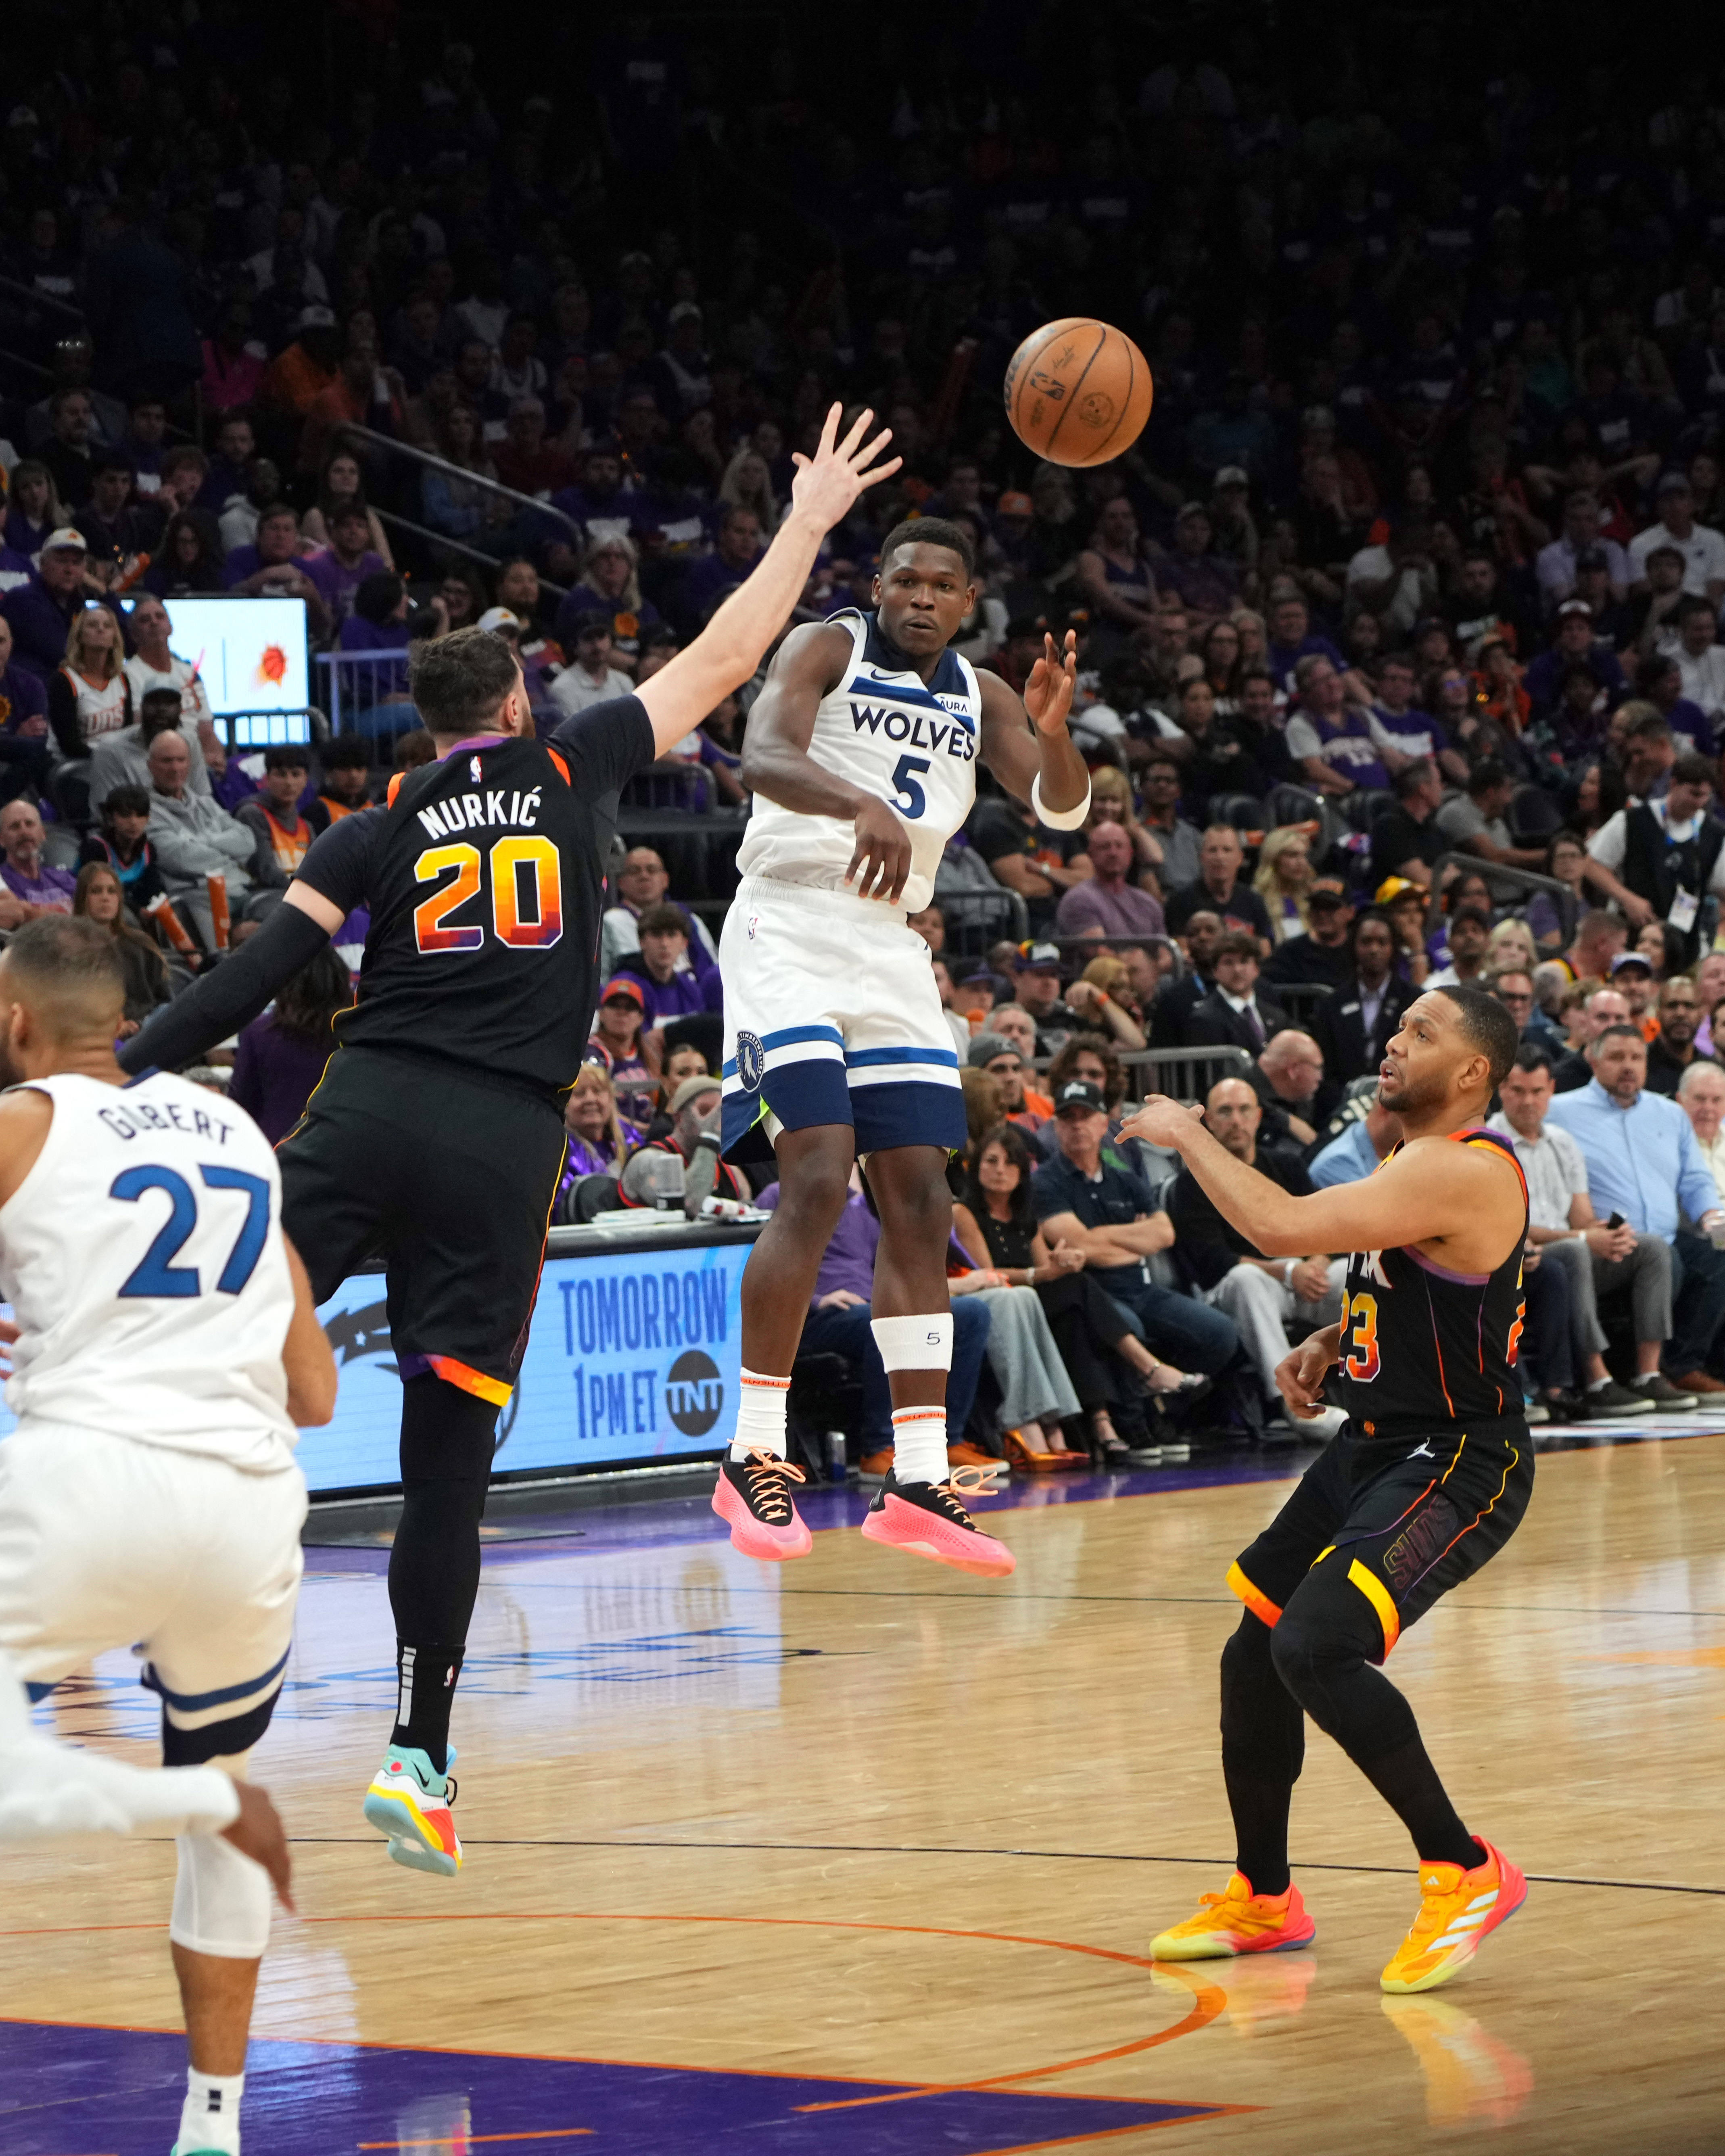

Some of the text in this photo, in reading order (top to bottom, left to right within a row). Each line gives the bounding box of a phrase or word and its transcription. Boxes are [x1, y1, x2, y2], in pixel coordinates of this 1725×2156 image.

[850, 702, 974, 761] WOLVES
[417, 786, 542, 840] NURKIĆ
[888, 754, 931, 819] 5
[413, 835, 563, 955] 20
[739, 1032, 763, 1075] TIMBERWOLVES
[109, 1163, 270, 1298] 27
[559, 1267, 727, 1356] TOMORROW
[927, 1332, 940, 1345] 5
[665, 1377, 724, 1415] TNT
